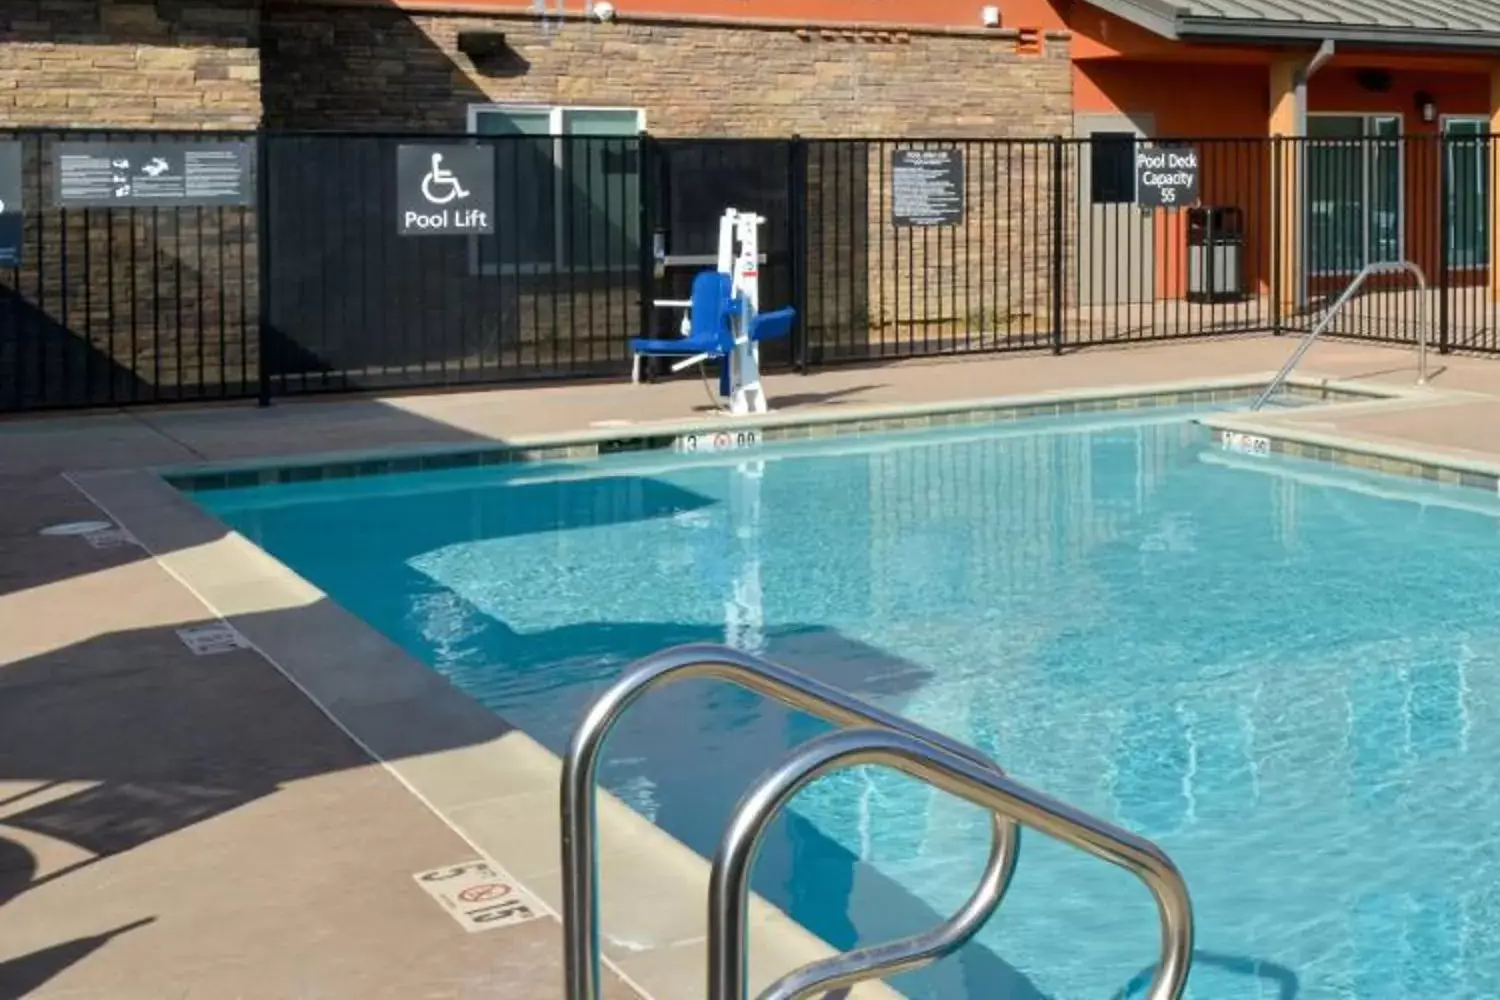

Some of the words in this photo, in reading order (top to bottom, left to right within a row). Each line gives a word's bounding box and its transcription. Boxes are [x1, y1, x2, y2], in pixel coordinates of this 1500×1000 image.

[1136, 152, 1166, 169] Pool
[1168, 151, 1198, 169] Deck
[1142, 170, 1194, 189] Capacity
[1161, 187, 1176, 203] 55
[405, 208, 448, 229] Pool
[455, 208, 488, 228] Lift
